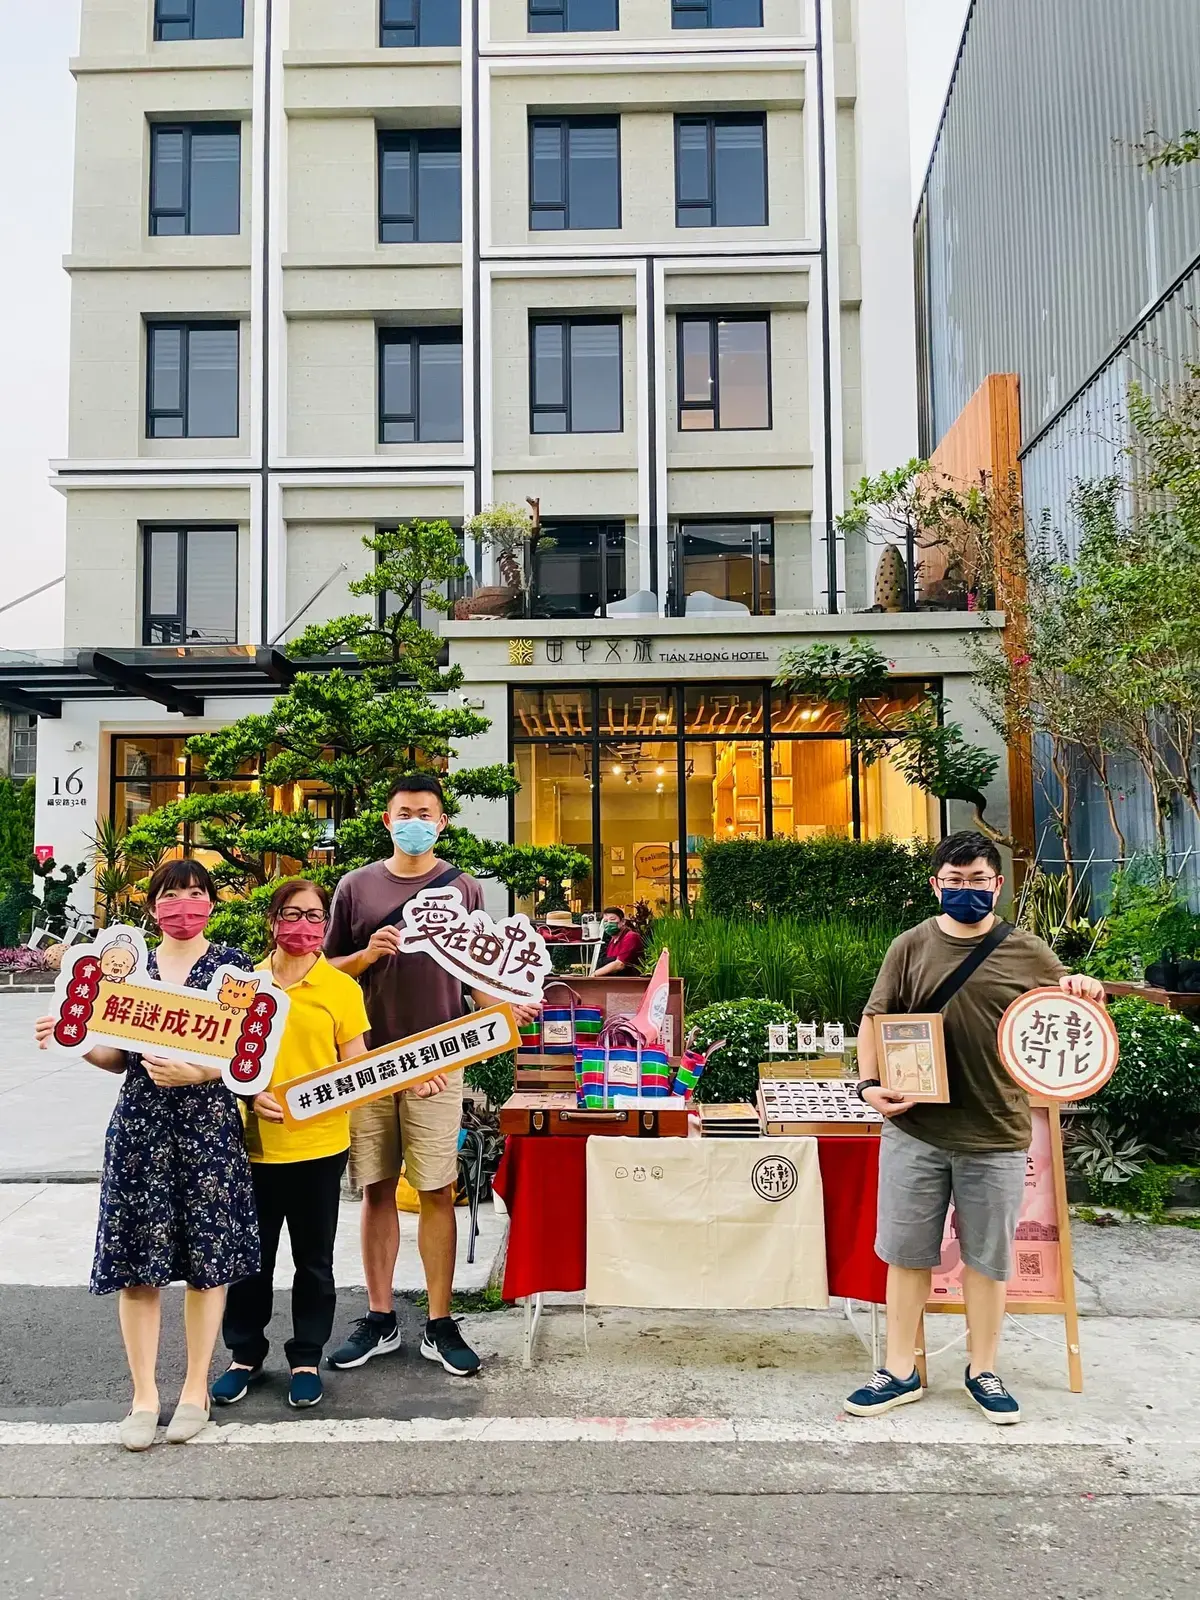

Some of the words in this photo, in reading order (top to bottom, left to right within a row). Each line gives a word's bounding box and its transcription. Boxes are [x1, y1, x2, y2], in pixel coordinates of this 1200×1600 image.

[659, 653, 686, 662] TIAN
[689, 652, 729, 661] ZHONG
[732, 651, 769, 660] HOTEL
[52, 766, 83, 795] 16
[62, 963, 97, 1039] 實境解謎
[101, 994, 232, 1045] 解謎成功!
[238, 1001, 269, 1075] 尋找回憶
